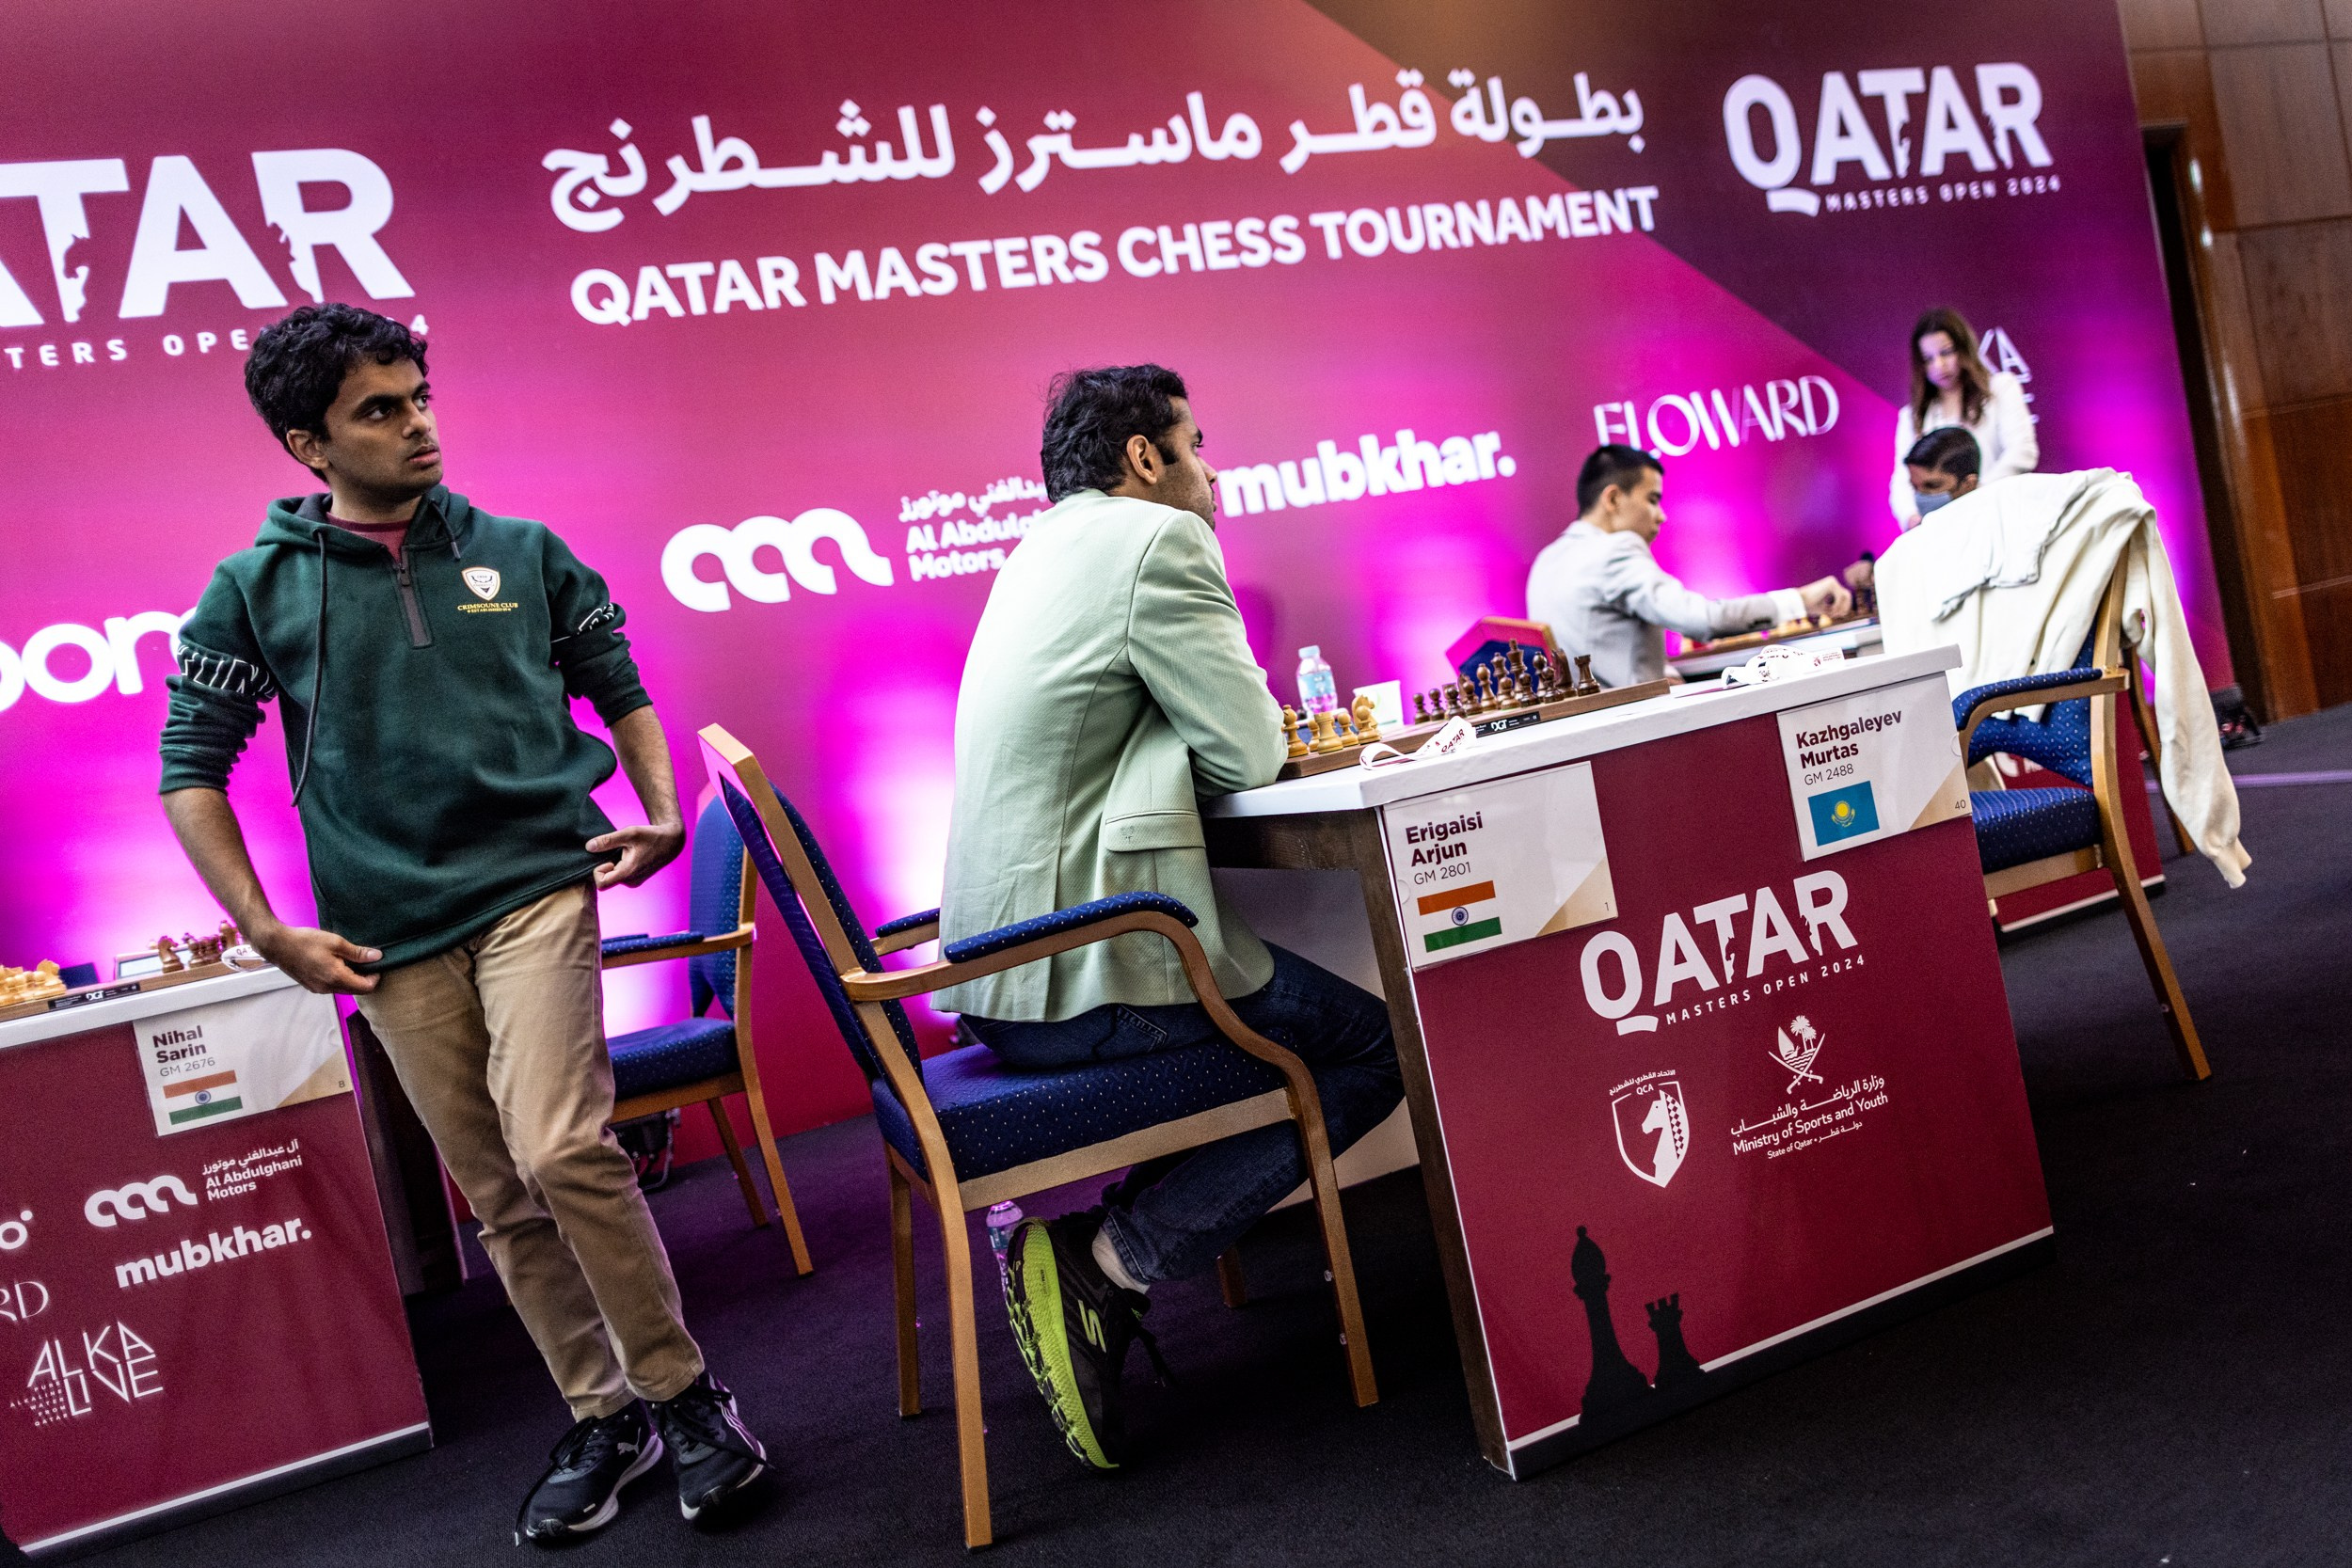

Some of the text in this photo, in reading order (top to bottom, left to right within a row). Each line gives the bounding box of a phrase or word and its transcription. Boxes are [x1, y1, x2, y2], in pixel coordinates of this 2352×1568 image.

[542, 69, 1645, 232] بطولة قطر ماسترز للشطرنج
[1723, 62, 2054, 216] QATAR
[1825, 174, 2061, 212] MASTERS OPEN 2024
[0, 148, 415, 328] TAR
[570, 186, 1659, 326] QATAR MASTERS CHESS TOURNAMENT
[162, 327, 266, 357] OPE
[1216, 428, 1517, 517] mubkhar.
[898, 490, 966, 522] موتورز
[906, 524, 939, 553] Al
[908, 547, 1007, 581] Motors
[1491, 720, 1507, 731] DGT
[1795, 710, 1902, 749] Kazhgaleyev
[1441, 729, 1465, 752] QATAR
[1800, 741, 1859, 769] Murtas
[1804, 763, 1854, 785] GM 2488
[1954, 800, 1966, 810] 40
[1406, 812, 1484, 845] Erigaisi
[1411, 840, 1468, 866] Arjun
[1414, 862, 1471, 885] GM 2801
[1604, 902, 1610, 911] 1
[1580, 869, 1858, 1036] QATAR
[86, 990, 105, 1001] DGT
[1666, 955, 1865, 1024] MASTERS OPEN 2024
[152, 1024, 203, 1049] Nihal
[156, 1043, 206, 1064] Sarin
[160, 1056, 215, 1077] GM 2676
[1636, 1084, 1654, 1095] QCA
[1730, 1074, 1884, 1137] وزارة الرياضة والشباب
[1733, 1091, 1888, 1156] Ministry of Sports and Youth
[1819, 1129, 1840, 1143] قطر
[202, 1138, 299, 1176] آل عبدالغني موتورز
[1767, 1138, 1813, 1159] State of Qatar
[206, 1155, 303, 1189] Al Abdulghani
[207, 1181, 257, 1200] Motors
[115, 1217, 312, 1289] mubkhar.
[27, 1321, 155, 1388] ALKA
[9, 1389, 62, 1408] ALKALINE
[34, 1381, 60, 1392] PURE
[30, 1397, 64, 1411] WATER
[38, 1405, 66, 1417] FROM
[34, 1413, 68, 1427] QATAR
